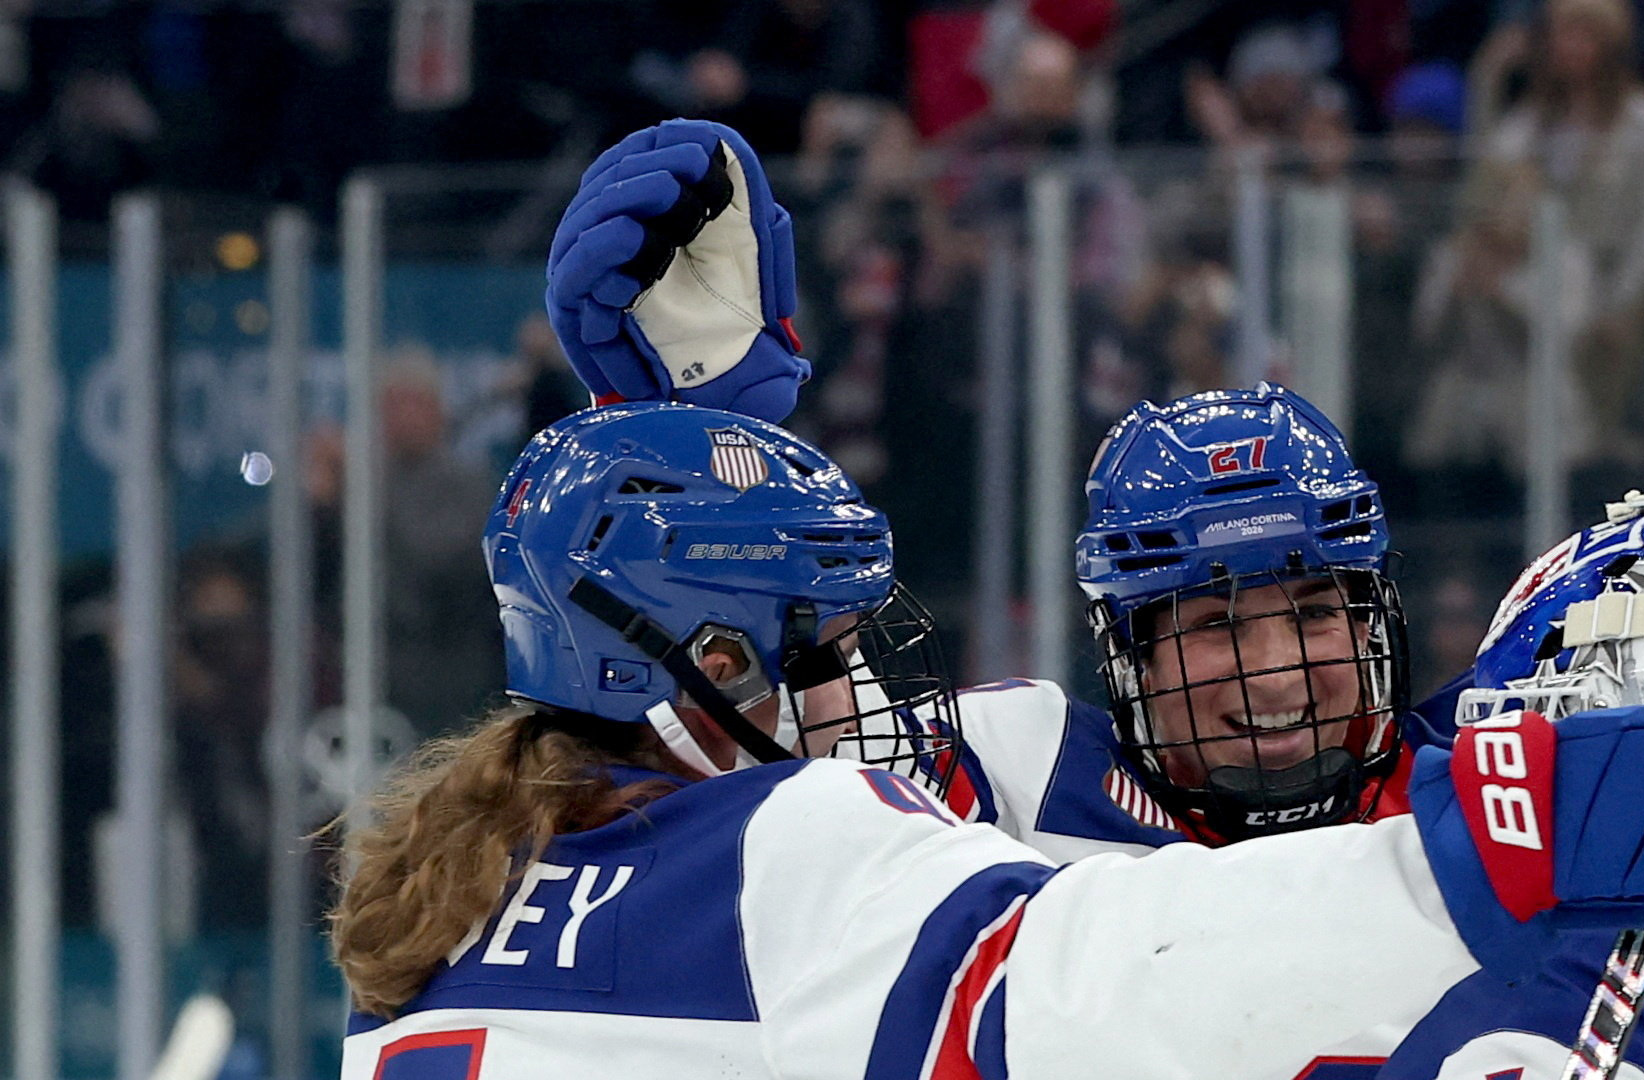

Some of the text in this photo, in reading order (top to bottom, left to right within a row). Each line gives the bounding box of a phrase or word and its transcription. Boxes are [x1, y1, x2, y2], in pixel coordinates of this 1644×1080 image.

[715, 432, 750, 447] USA
[1207, 436, 1268, 477] 27
[1204, 511, 1297, 534] MILANO CORTINA
[1240, 525, 1264, 537] 2026
[1244, 794, 1336, 826] CCM
